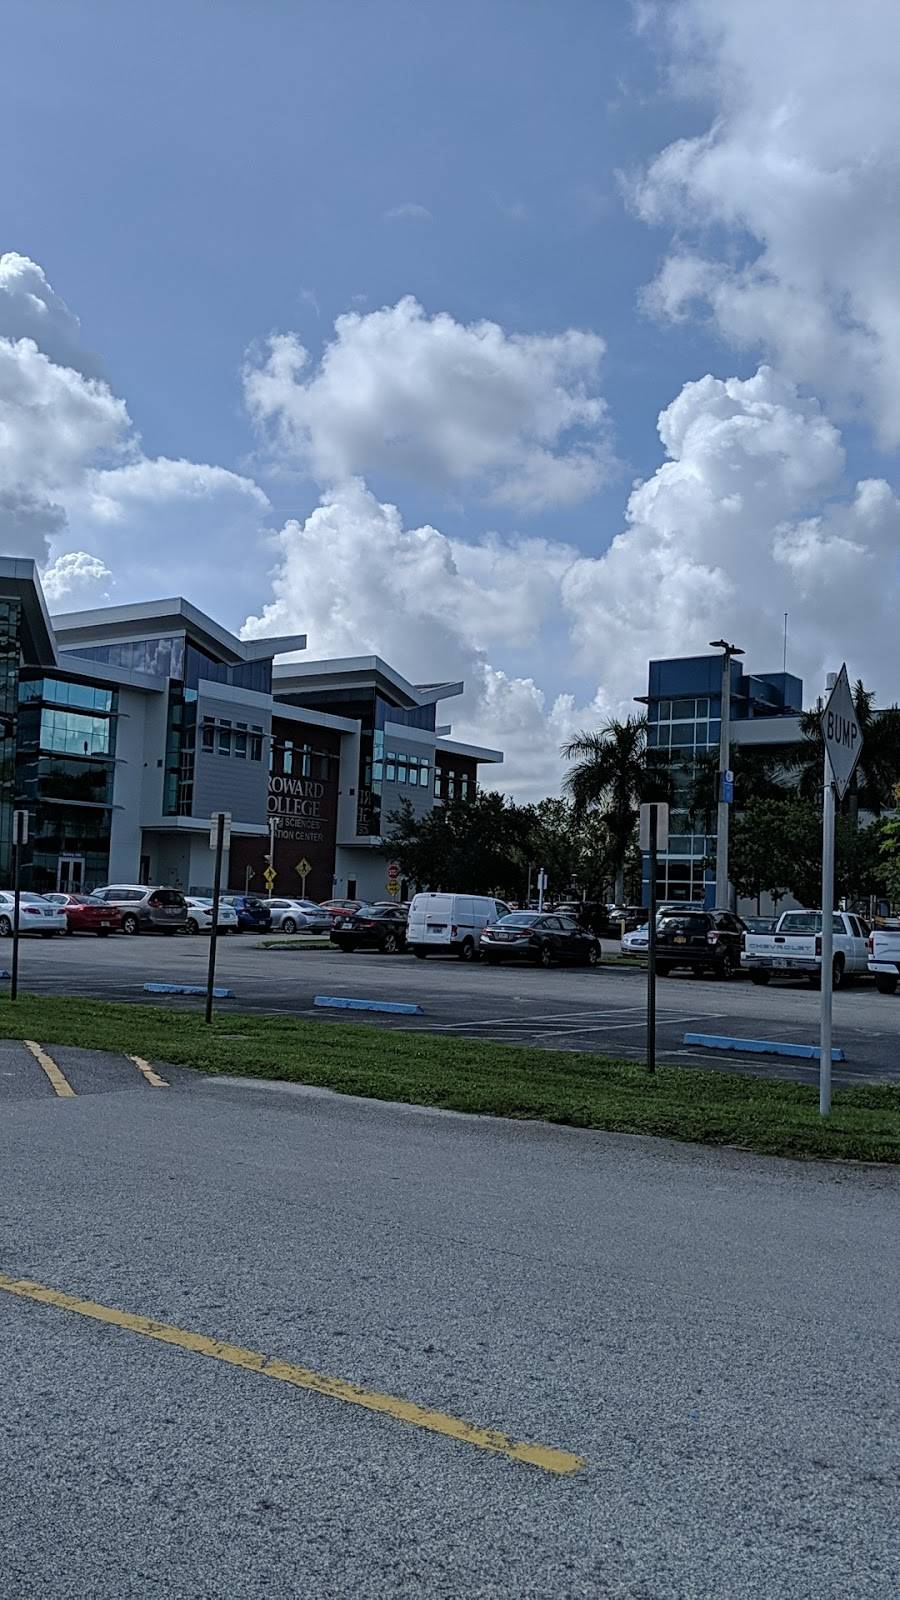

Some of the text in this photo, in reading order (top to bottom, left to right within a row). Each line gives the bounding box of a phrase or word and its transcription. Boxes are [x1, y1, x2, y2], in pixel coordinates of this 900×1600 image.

[827, 711, 858, 750] BUMP
[267, 795, 320, 817] OLLEGE
[285, 818, 321, 830] SCIENCES
[295, 831, 324, 842] CENTER
[749, 943, 812, 951] CHEVROLET
